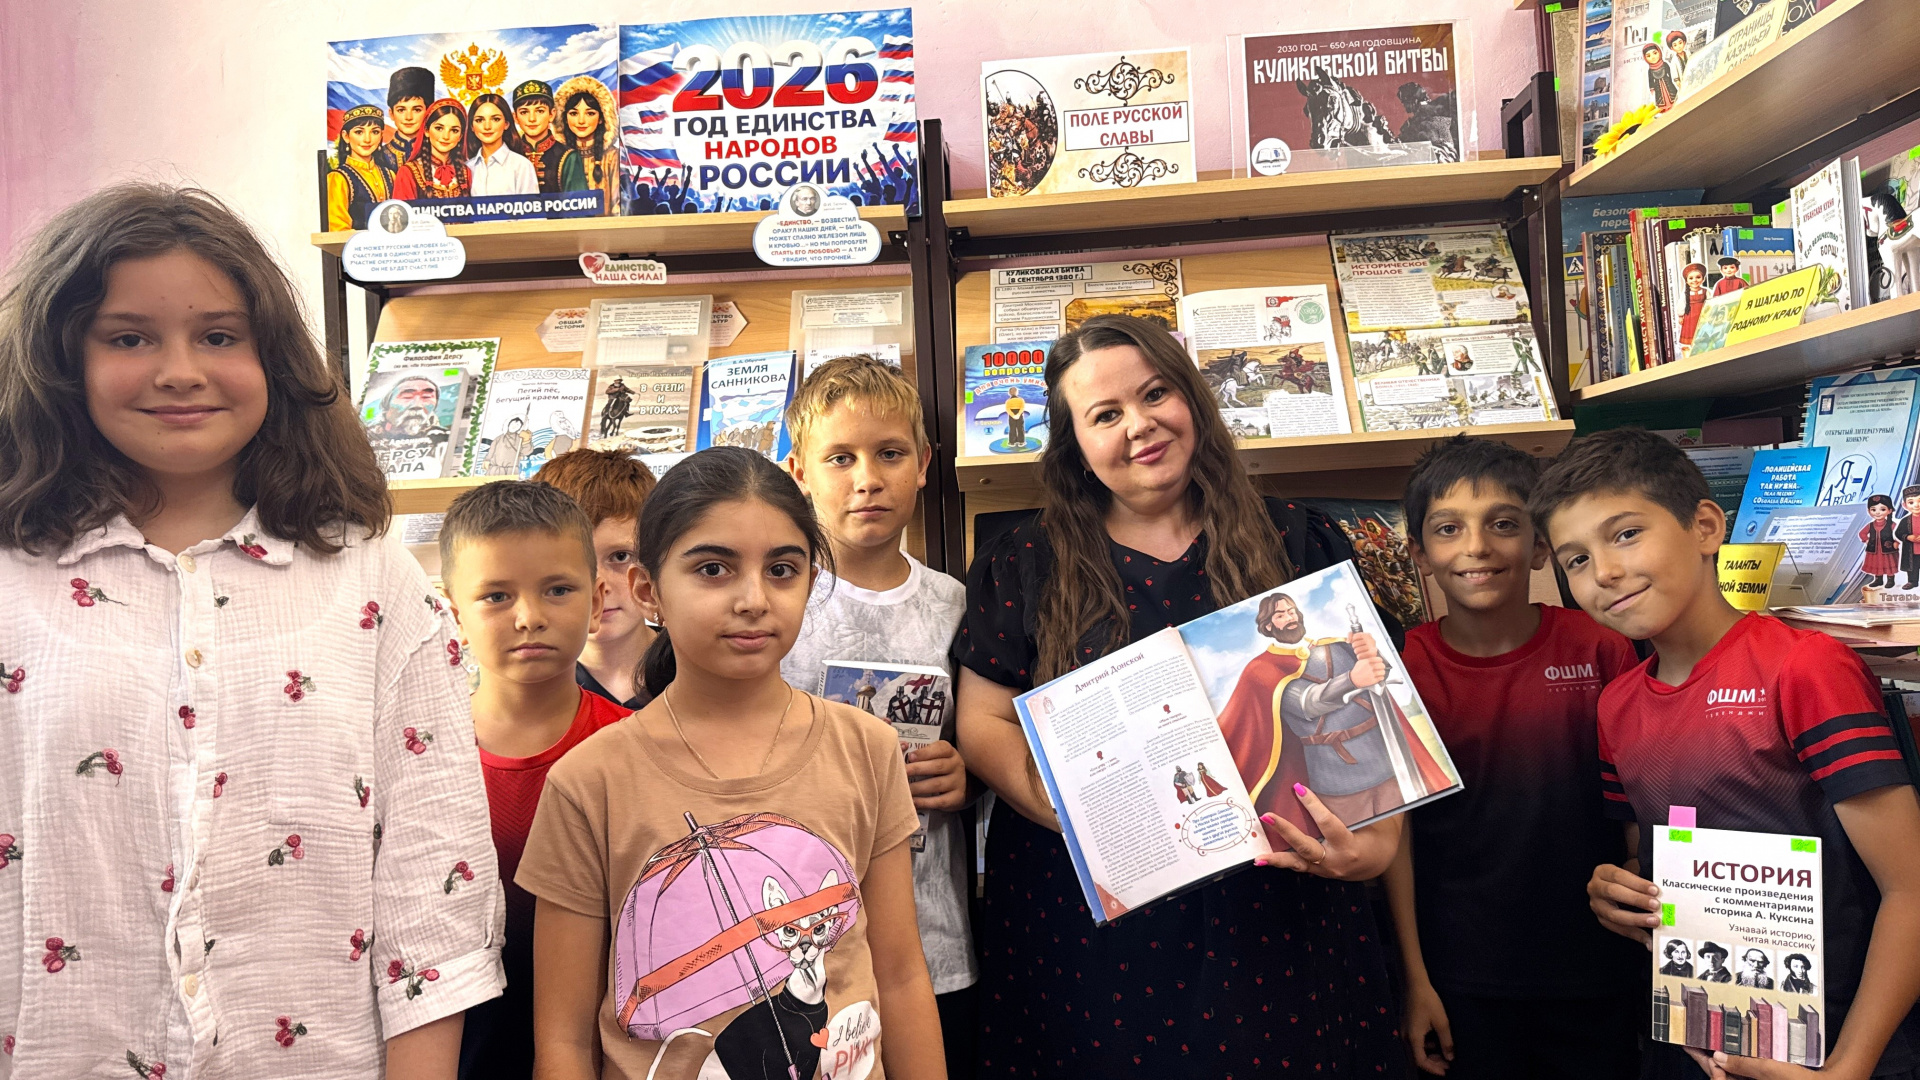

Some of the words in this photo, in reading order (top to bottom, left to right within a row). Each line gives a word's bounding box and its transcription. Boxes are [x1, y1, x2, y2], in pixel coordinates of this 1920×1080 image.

[1728, 7, 1775, 47] СТРАНИЦЫ
[1277, 45, 1298, 54] 2030
[1299, 43, 1318, 52] ГОД
[1329, 40, 1360, 51] 650-АЯ
[1362, 36, 1422, 49] ГОДОВЩИНА
[1724, 25, 1771, 63] КАЗАЧЬЕЙ
[672, 36, 879, 112] 2026
[1254, 47, 1378, 84] КУЛИКОВСКОЙ
[1385, 47, 1448, 75] БИТВЫ
[674, 116, 728, 138] ГОД
[737, 108, 877, 136] ЕДИНСТВА
[1070, 111, 1109, 129] ПОЛЕ
[1113, 103, 1183, 126] РУССКОЙ
[1100, 129, 1154, 147] СЛАВЫ
[704, 136, 837, 160] НАРОДОВ
[700, 158, 850, 190] РОССИИ
[412, 204, 474, 217] ДИНСТВА
[477, 200, 543, 216] НАРОДОВ
[545, 197, 597, 212] РОССИИ
[1601, 219, 1631, 229] пере
[831, 238, 868, 246] ПОПРОБУЕМ
[1653, 226, 1661, 252] письма
[604, 263, 656, 272] ЕДИНСТВО
[1005, 268, 1060, 277] КУЛИКОВСКАЯ
[1060, 266, 1085, 274] БИТВА
[1351, 261, 1428, 270] ИСТОРИЧЕСКОЕ
[595, 273, 628, 281] НАША
[630, 272, 663, 281] СИЛА!
[1017, 275, 1054, 283] СЕНТЯБРЯ
[1656, 252, 1667, 307] Миссионерские
[1636, 277, 1647, 324] ХРИСТОВ
[1745, 299, 1753, 310] Я
[1754, 290, 1789, 308] ШАГАЮ
[1790, 287, 1804, 300] ПО
[1730, 313, 1771, 332] РОДНОМУ
[1772, 306, 1803, 321] КРАЮ
[1640, 325, 1650, 356] КРЕСТ
[982, 349, 1044, 368] 10000
[727, 364, 768, 376] ЗЕМЛЯ
[984, 366, 1043, 377] вопросов
[640, 384, 647, 393] В
[653, 383, 685, 392] СТЕПИ
[711, 373, 787, 389] САННИКОВА
[974, 382, 993, 396] для
[993, 377, 1021, 386] очень
[1023, 378, 1047, 387] умны
[517, 386, 542, 394] Пегий
[496, 395, 530, 403] бегущий
[657, 394, 665, 404] И
[640, 406, 646, 415] В
[1825, 428, 1853, 437] ОТКРЫТЫЙ
[1854, 426, 1894, 436] ЛИТЕРАТУРНЫЙ
[380, 449, 430, 461] ЕРСУ
[386, 462, 425, 473] АЛА
[1771, 474, 1797, 482] РАБОТА
[1724, 560, 1762, 570] ТАЛАНТЫ
[1736, 583, 1767, 594] ЗЕМЛИ
[1075, 669, 1109, 694] Дмитрий
[1110, 652, 1144, 674] Донской
[1544, 663, 1594, 681] ФШМ
[1549, 685, 1598, 693] ГЕЛЕНДЖ
[1706, 688, 1756, 705] ФШМ
[1693, 860, 1812, 888] ИСТОРИЯ
[1662, 879, 1732, 894] Классические
[1735, 887, 1814, 902] произведения
[1723, 897, 1814, 913] комментариями
[1704, 906, 1752, 918] историка
[1755, 911, 1766, 920] А.
[1769, 913, 1814, 925] Куксина
[1729, 923, 1767, 935] Узнавай
[1770, 930, 1815, 942] историю,
[1743, 936, 1769, 944] читая
[1772, 939, 1816, 951] классику
